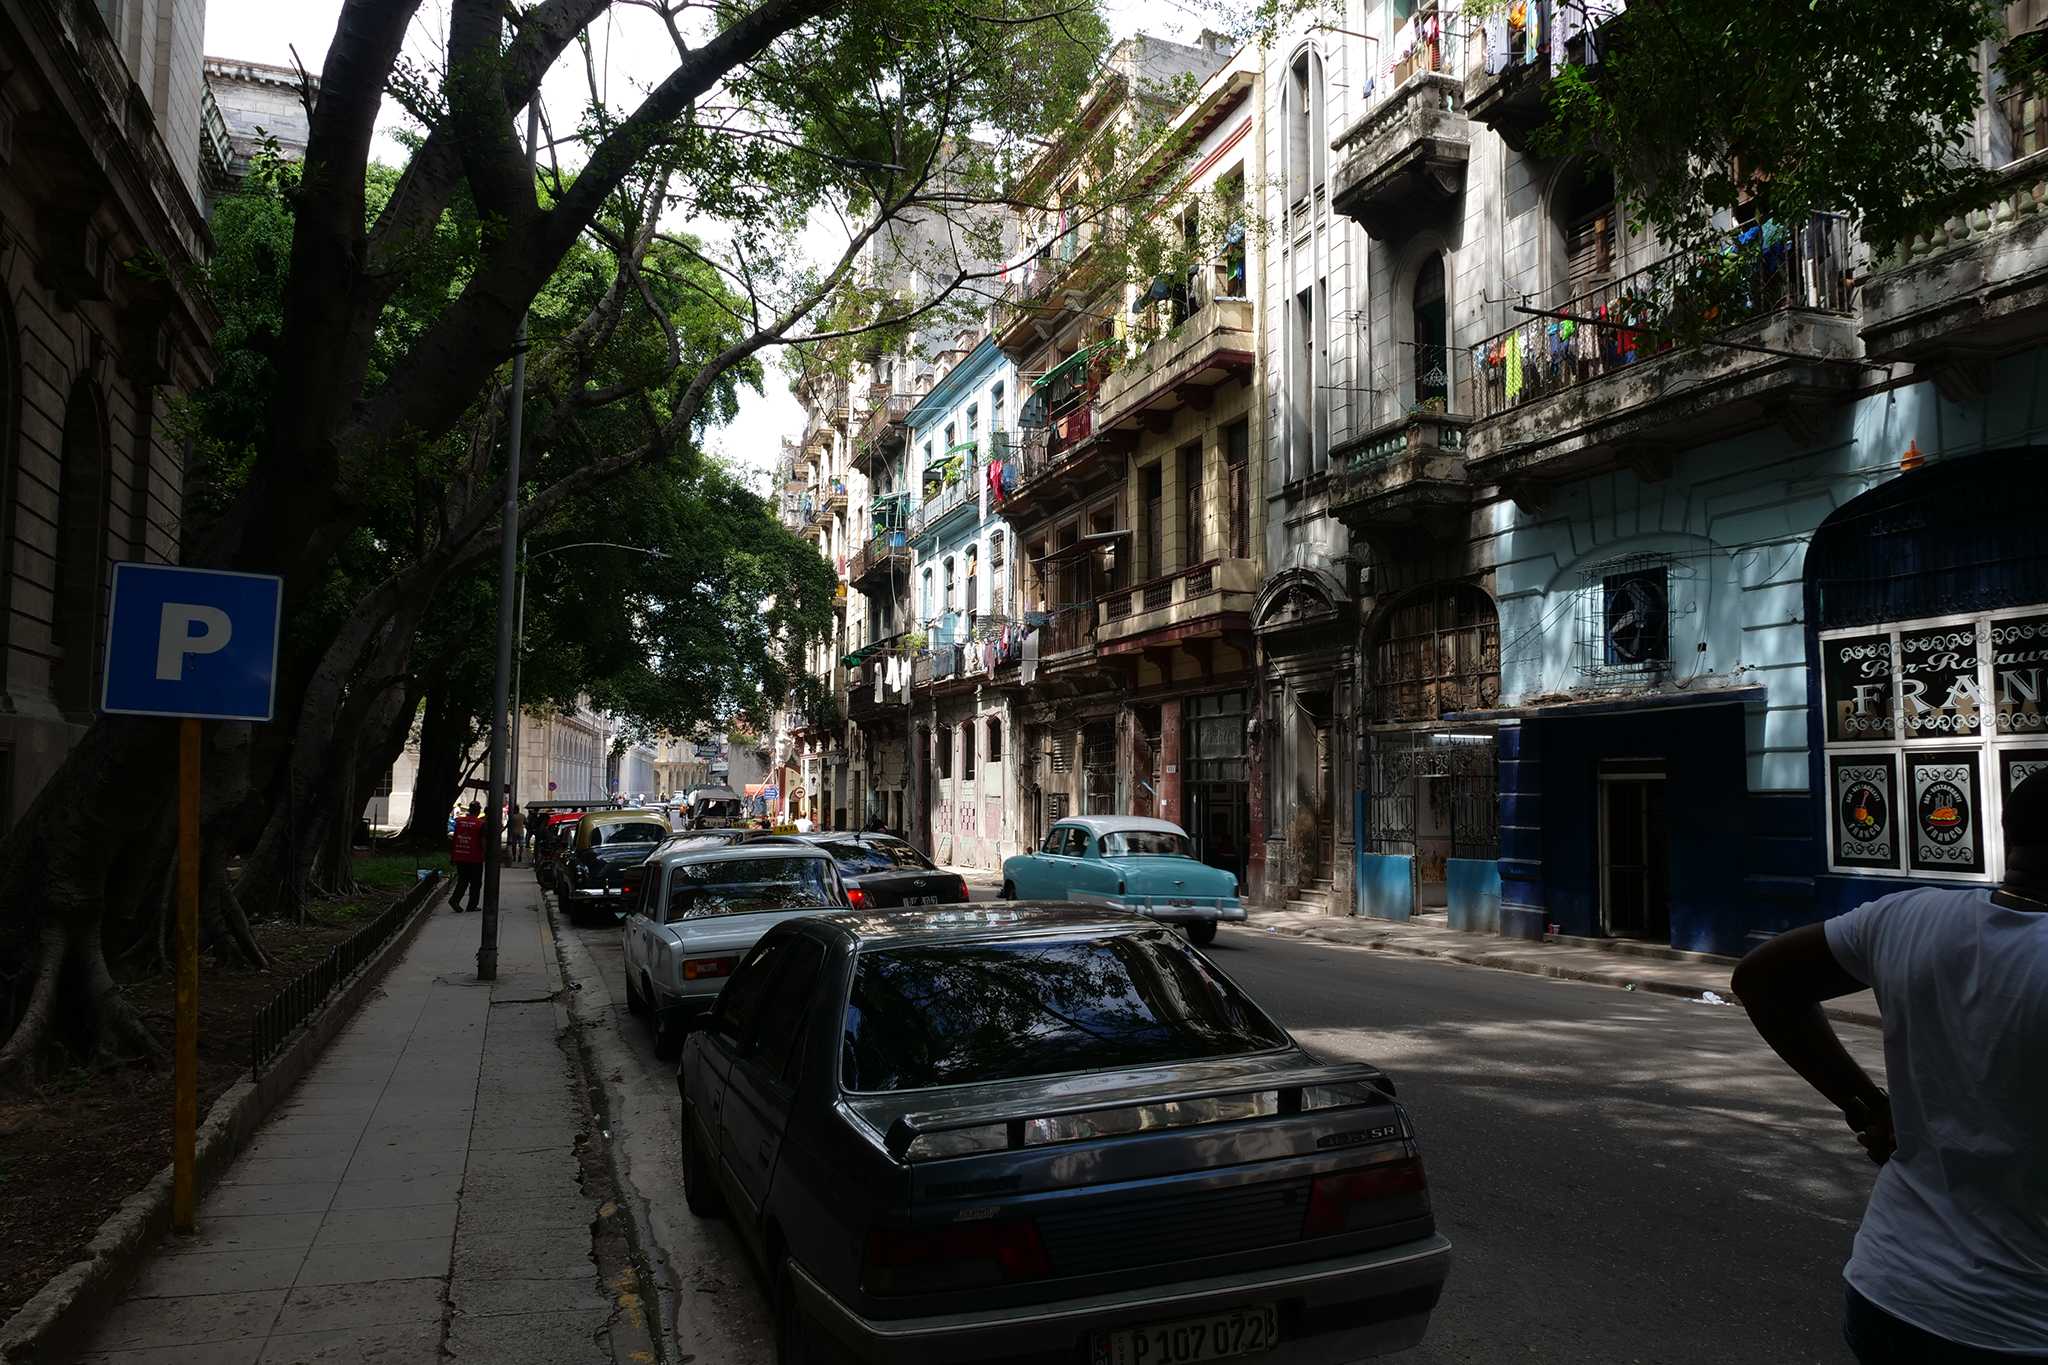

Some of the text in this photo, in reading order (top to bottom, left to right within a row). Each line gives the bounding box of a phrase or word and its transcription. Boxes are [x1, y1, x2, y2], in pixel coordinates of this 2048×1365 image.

[156, 602, 232, 681] P
[1853, 668, 2048, 715] FRAN
[1926, 825, 1963, 842] FRANCO
